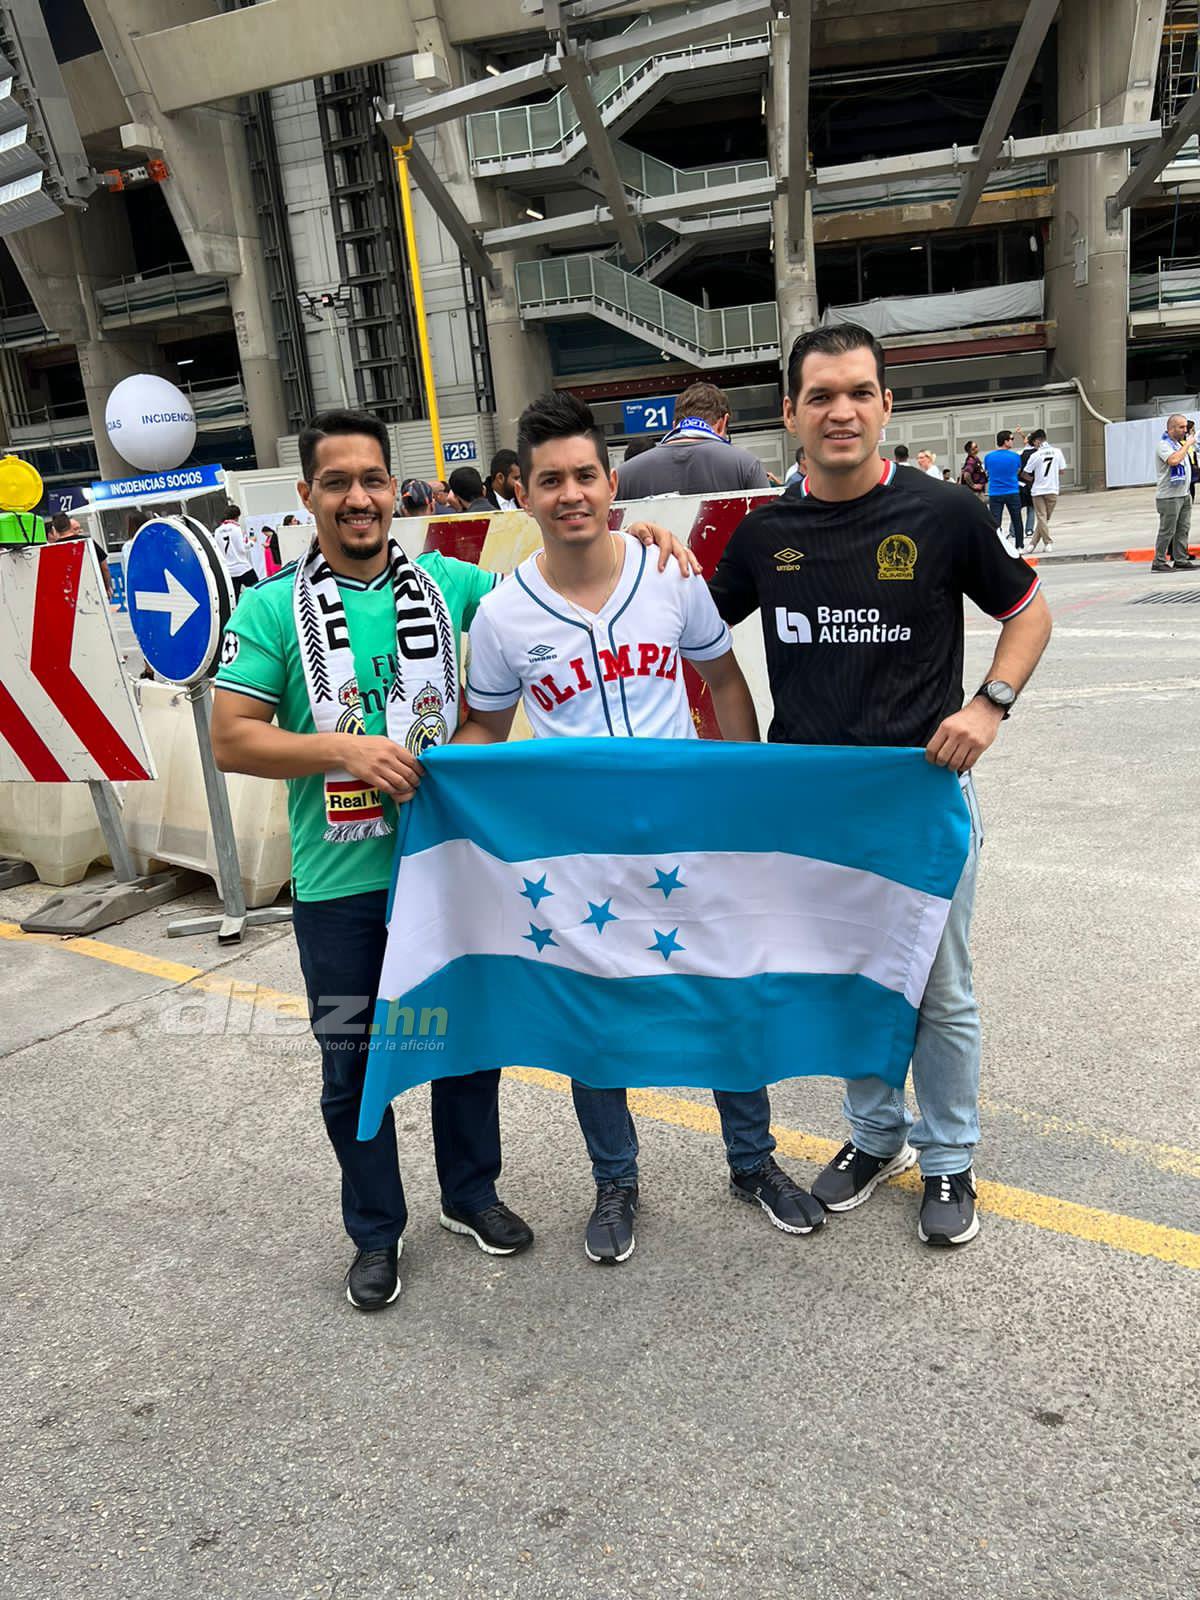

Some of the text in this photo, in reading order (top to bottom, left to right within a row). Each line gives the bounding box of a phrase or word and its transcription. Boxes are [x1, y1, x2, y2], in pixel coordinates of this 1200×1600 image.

[645, 406, 667, 428] 21
[451, 444, 470, 460] 23
[1043, 457, 1054, 477] 7
[110, 471, 203, 495] INCIDENCIAS SOCIOS
[60, 495, 73, 511] 27
[223, 536, 230, 555] 7
[776, 563, 801, 572] umbro
[817, 606, 880, 624] Banco
[819, 623, 911, 644] Atlántida
[330, 792, 367, 809] Real
